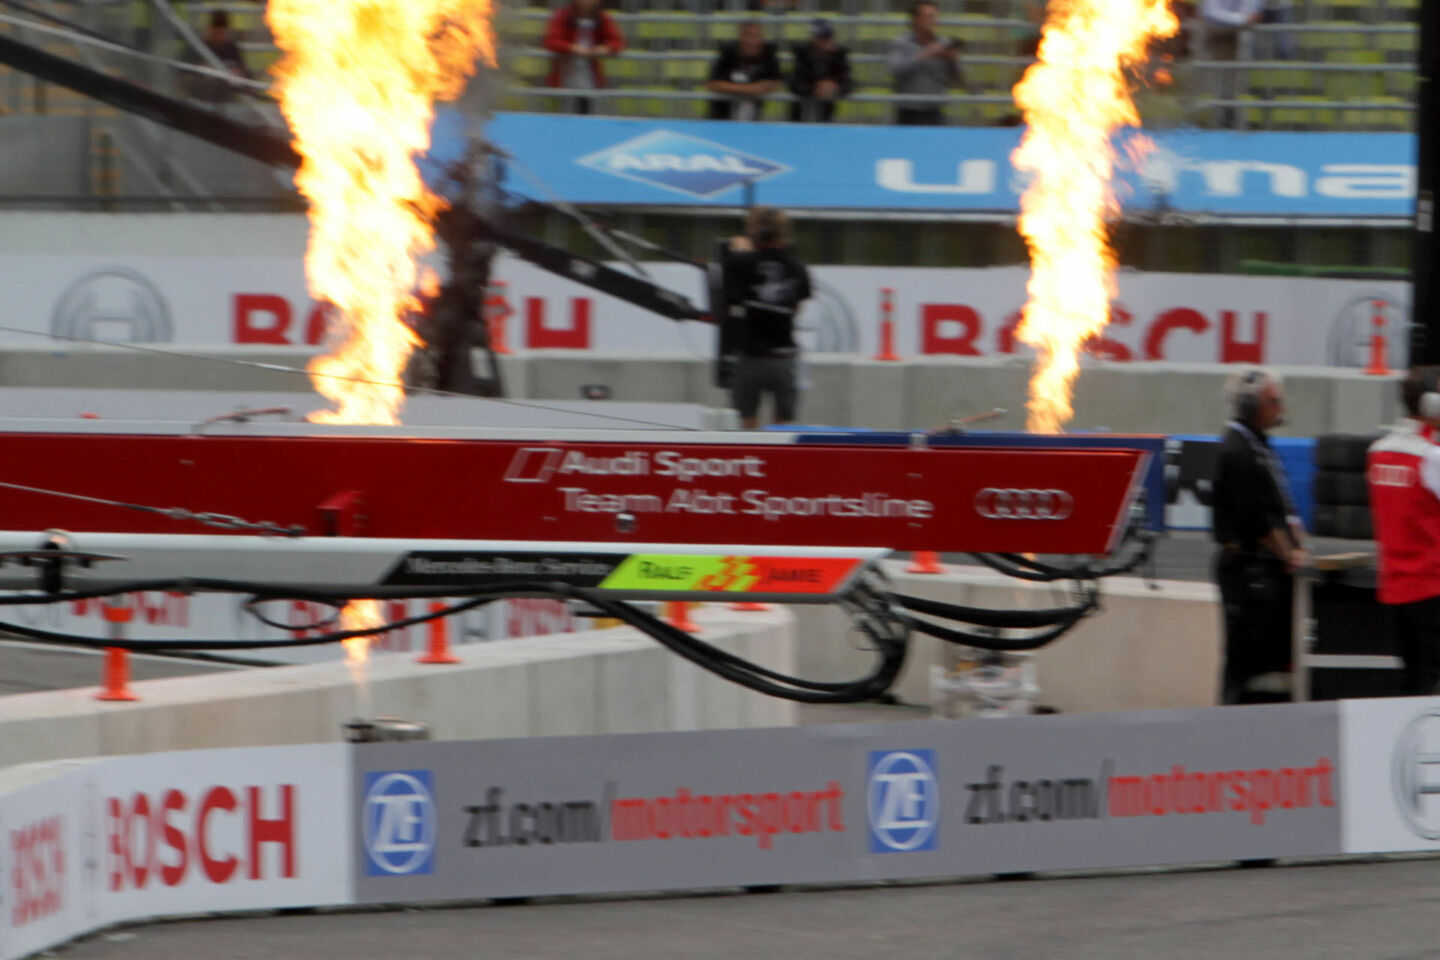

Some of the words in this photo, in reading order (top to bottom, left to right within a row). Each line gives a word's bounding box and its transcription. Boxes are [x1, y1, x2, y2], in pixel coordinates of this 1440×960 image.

[603, 151, 766, 178] ARAL
[558, 450, 649, 477] Audi
[654, 450, 766, 484] Sport
[557, 486, 662, 515] Team
[666, 488, 734, 516] Abt
[743, 490, 933, 521] Sportsline
[107, 784, 299, 892] BOSCH
